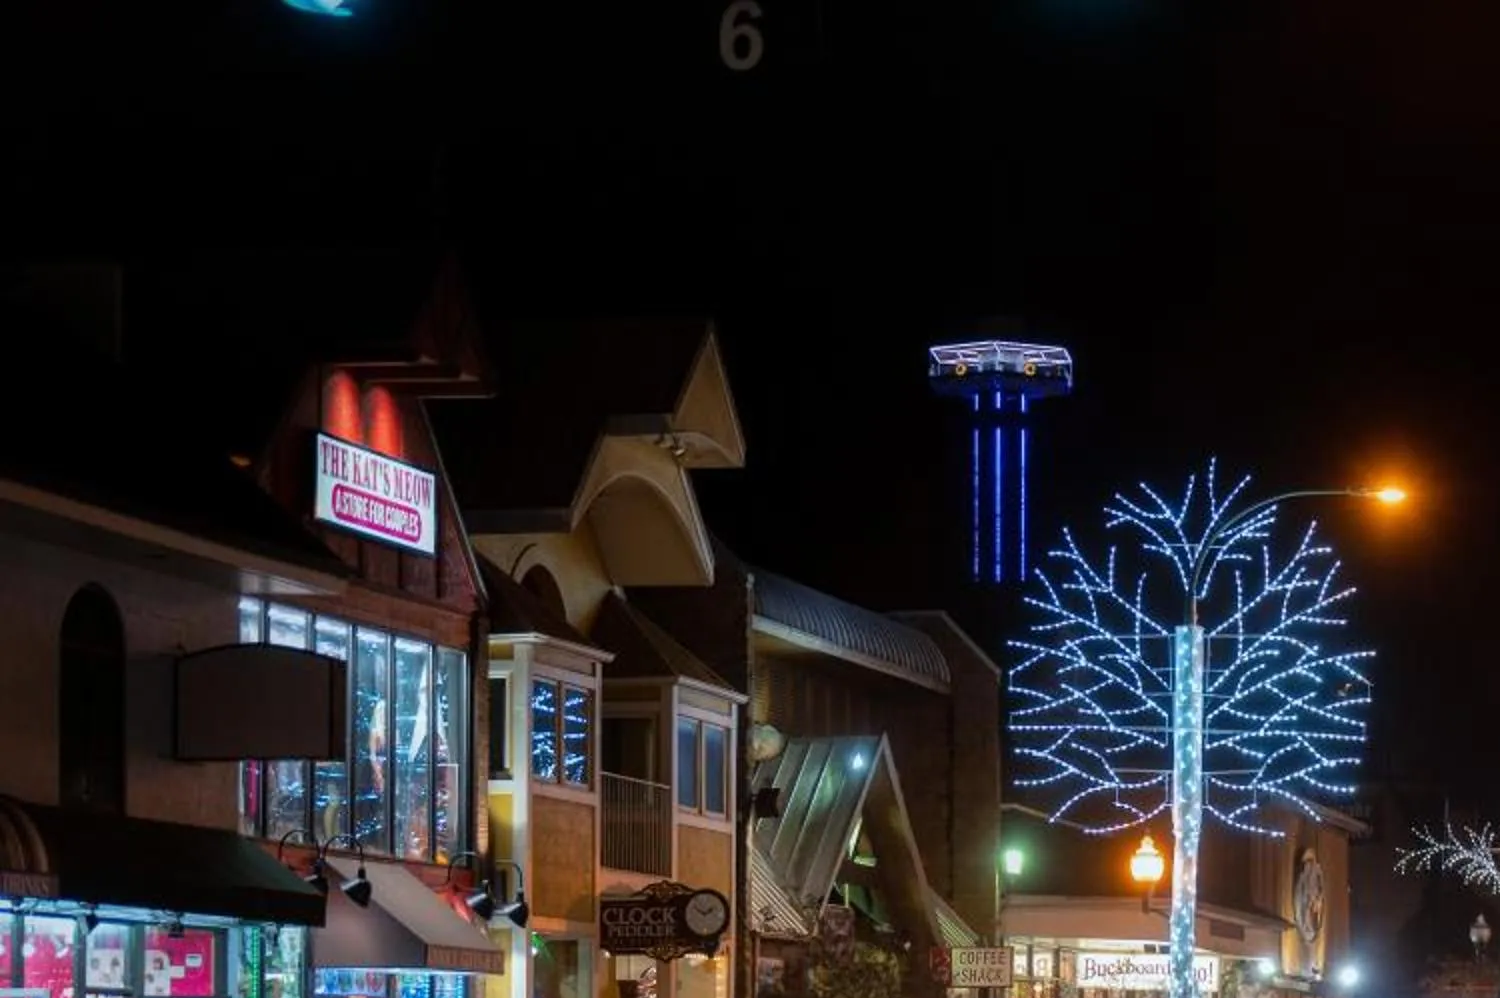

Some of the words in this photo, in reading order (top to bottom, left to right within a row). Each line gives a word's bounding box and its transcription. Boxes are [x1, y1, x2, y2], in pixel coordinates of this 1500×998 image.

[719, 0, 763, 70] 6
[320, 441, 348, 481] THE
[353, 451, 391, 496] KAT'S
[393, 464, 432, 509] MEOW
[342, 491, 369, 521] STORE
[369, 499, 385, 526] FOR
[603, 907, 677, 925] CLOCK
[959, 951, 1006, 965] COFFEE
[961, 967, 1004, 984] SHACK
